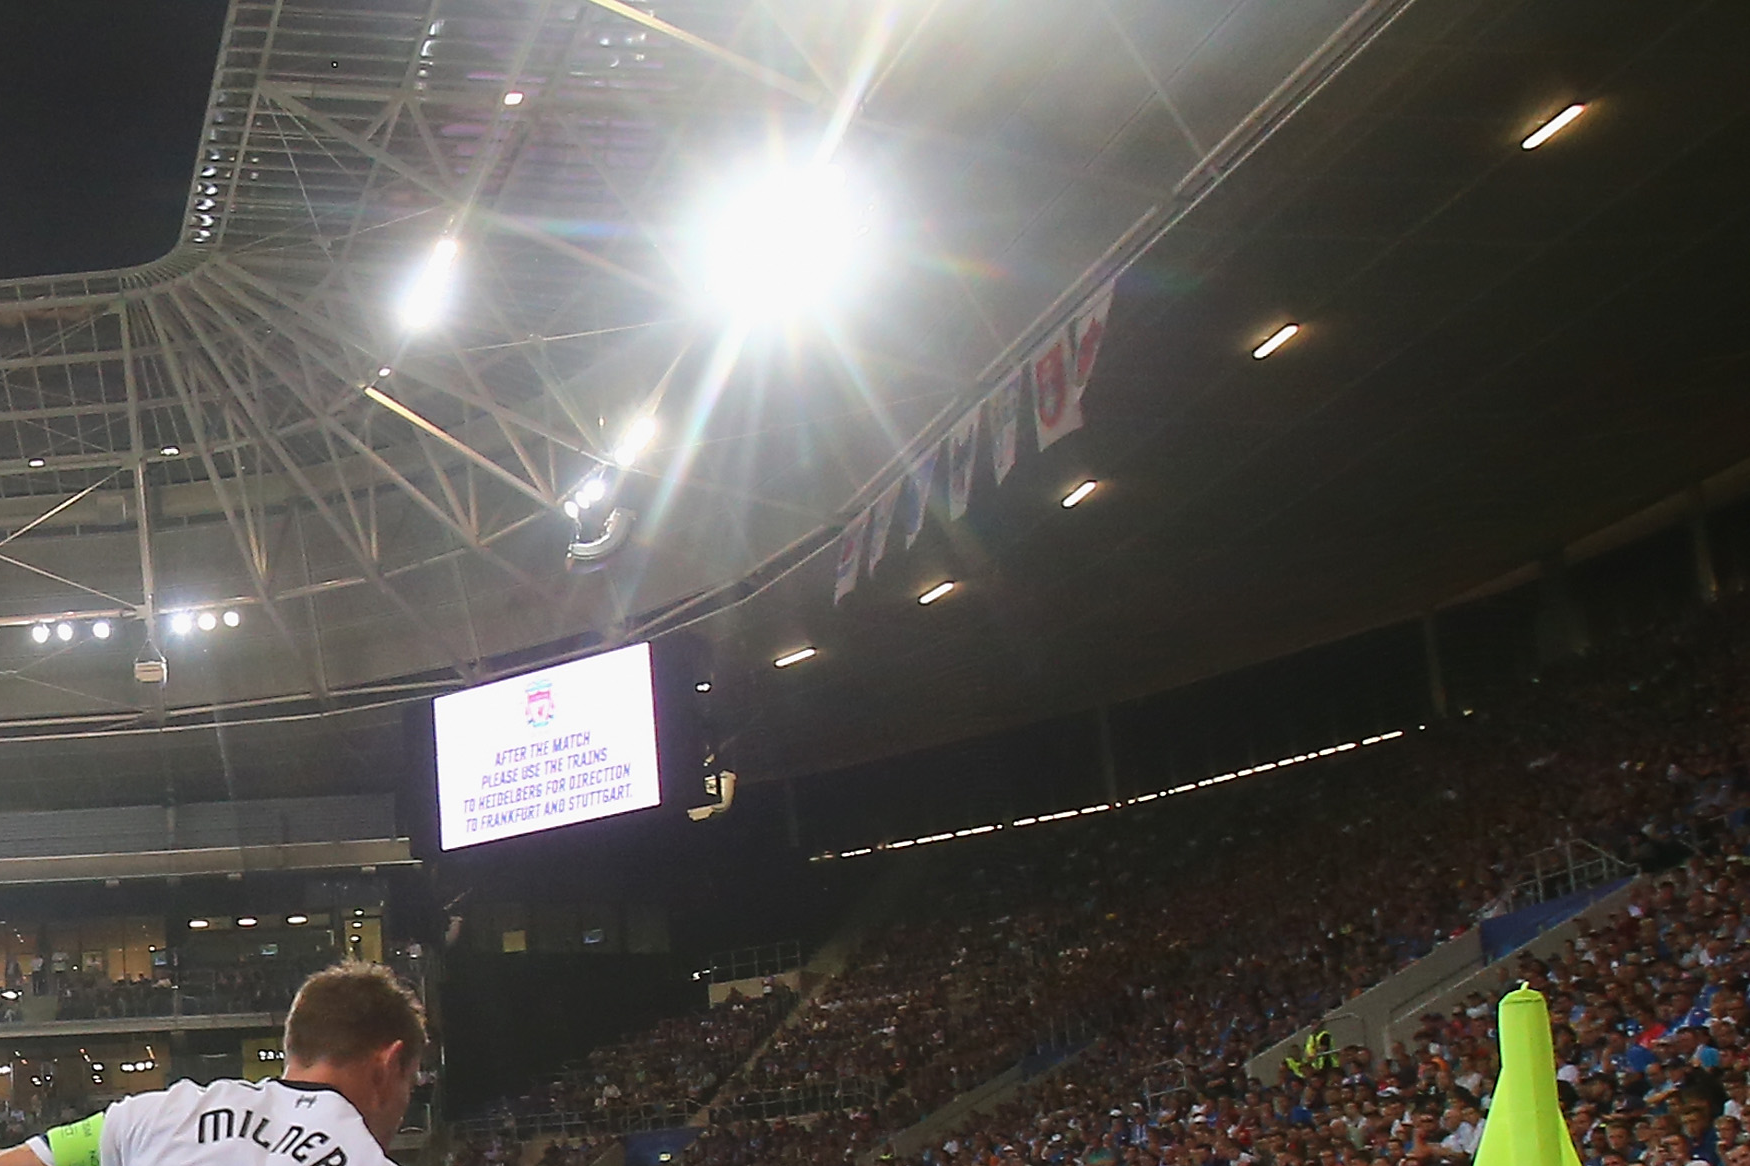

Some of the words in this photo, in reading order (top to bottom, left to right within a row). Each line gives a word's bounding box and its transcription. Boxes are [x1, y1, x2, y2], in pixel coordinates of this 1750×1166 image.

[495, 746, 527, 766] AFTER
[530, 740, 549, 758] THE
[553, 731, 590, 752] MATCH
[481, 767, 518, 789] PLEASE
[522, 762, 540, 779] USE
[545, 758, 563, 775] THE
[568, 747, 607, 769] TRAINS
[464, 798, 475, 813] TO
[479, 783, 542, 810] HEIDELBERG
[546, 778, 565, 795] FOR
[569, 763, 630, 790] DIRECTION
[467, 818, 478, 832] TO
[481, 803, 541, 829] FRANKFURT
[543, 799, 565, 816] AND
